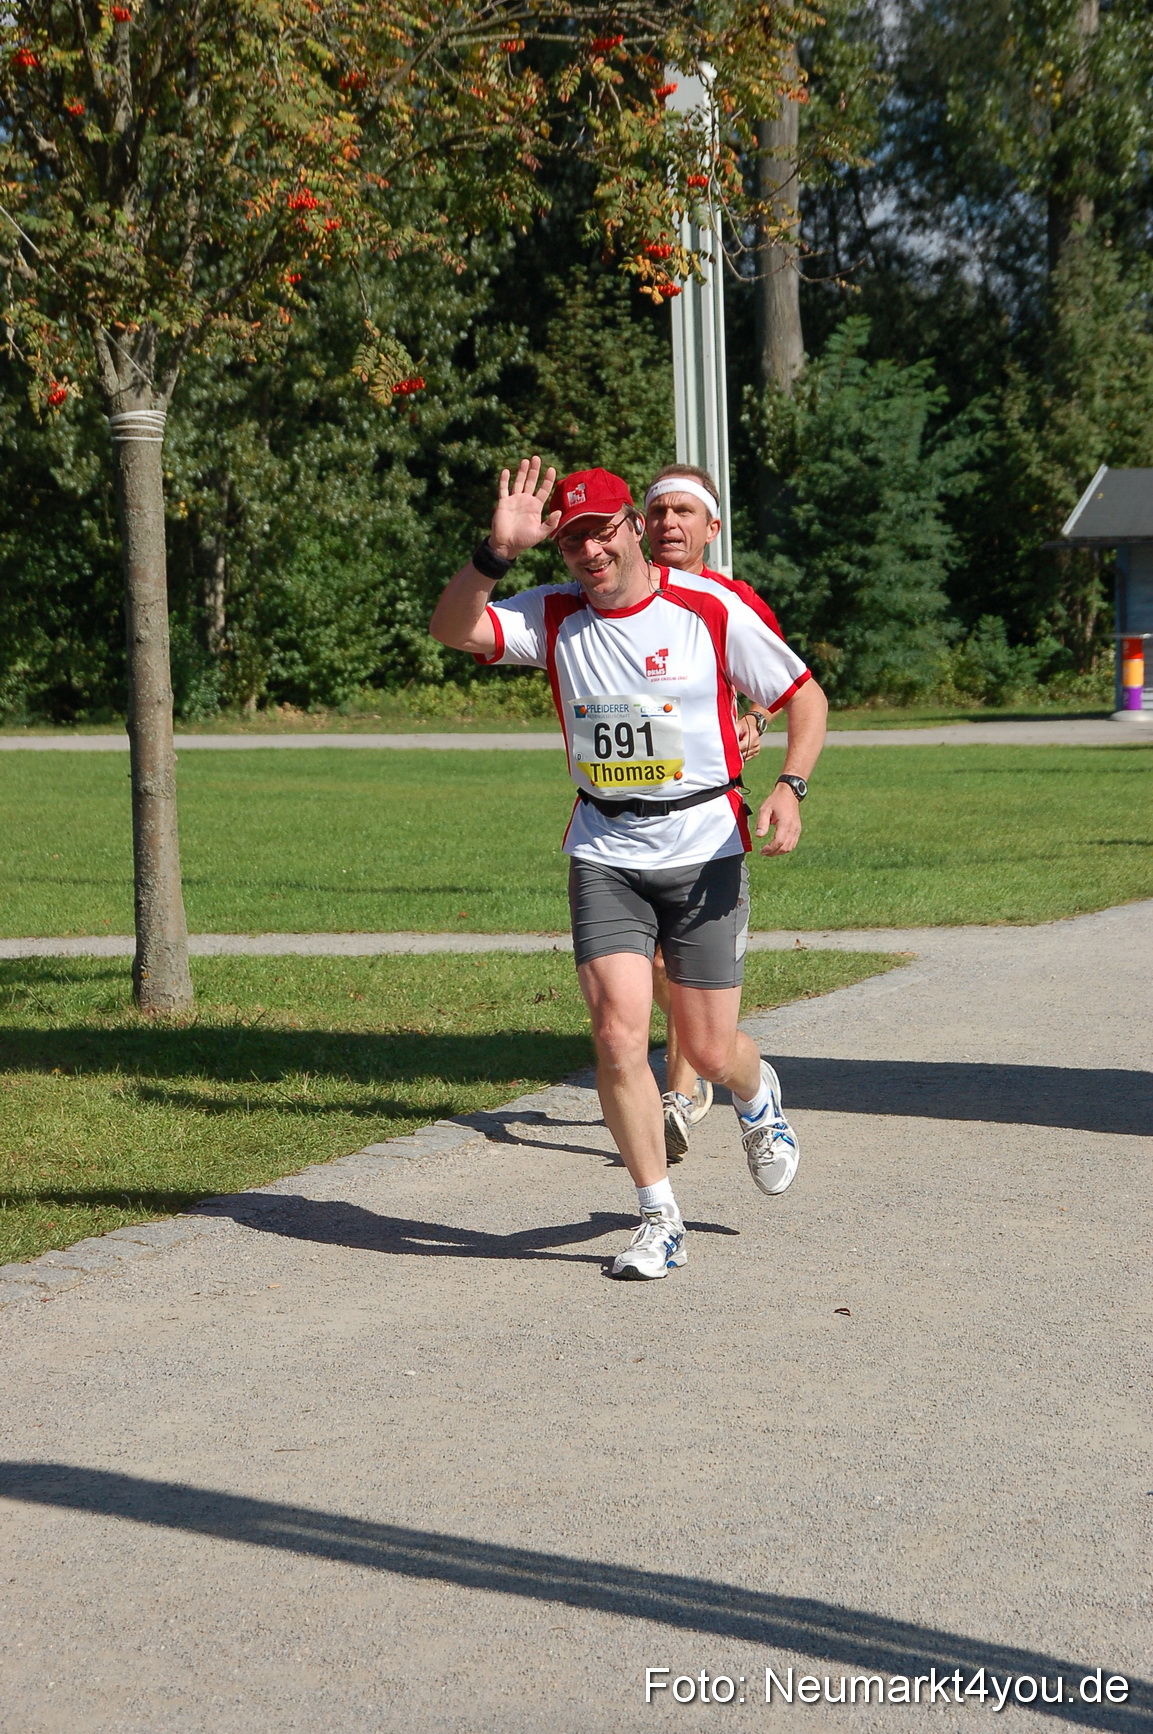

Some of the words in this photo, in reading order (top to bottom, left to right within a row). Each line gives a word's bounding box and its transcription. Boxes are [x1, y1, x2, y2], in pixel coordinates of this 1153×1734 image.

[586, 704, 630, 713] PFLEIDERER
[594, 722, 654, 759] 691
[590, 763, 666, 782] Thomas
